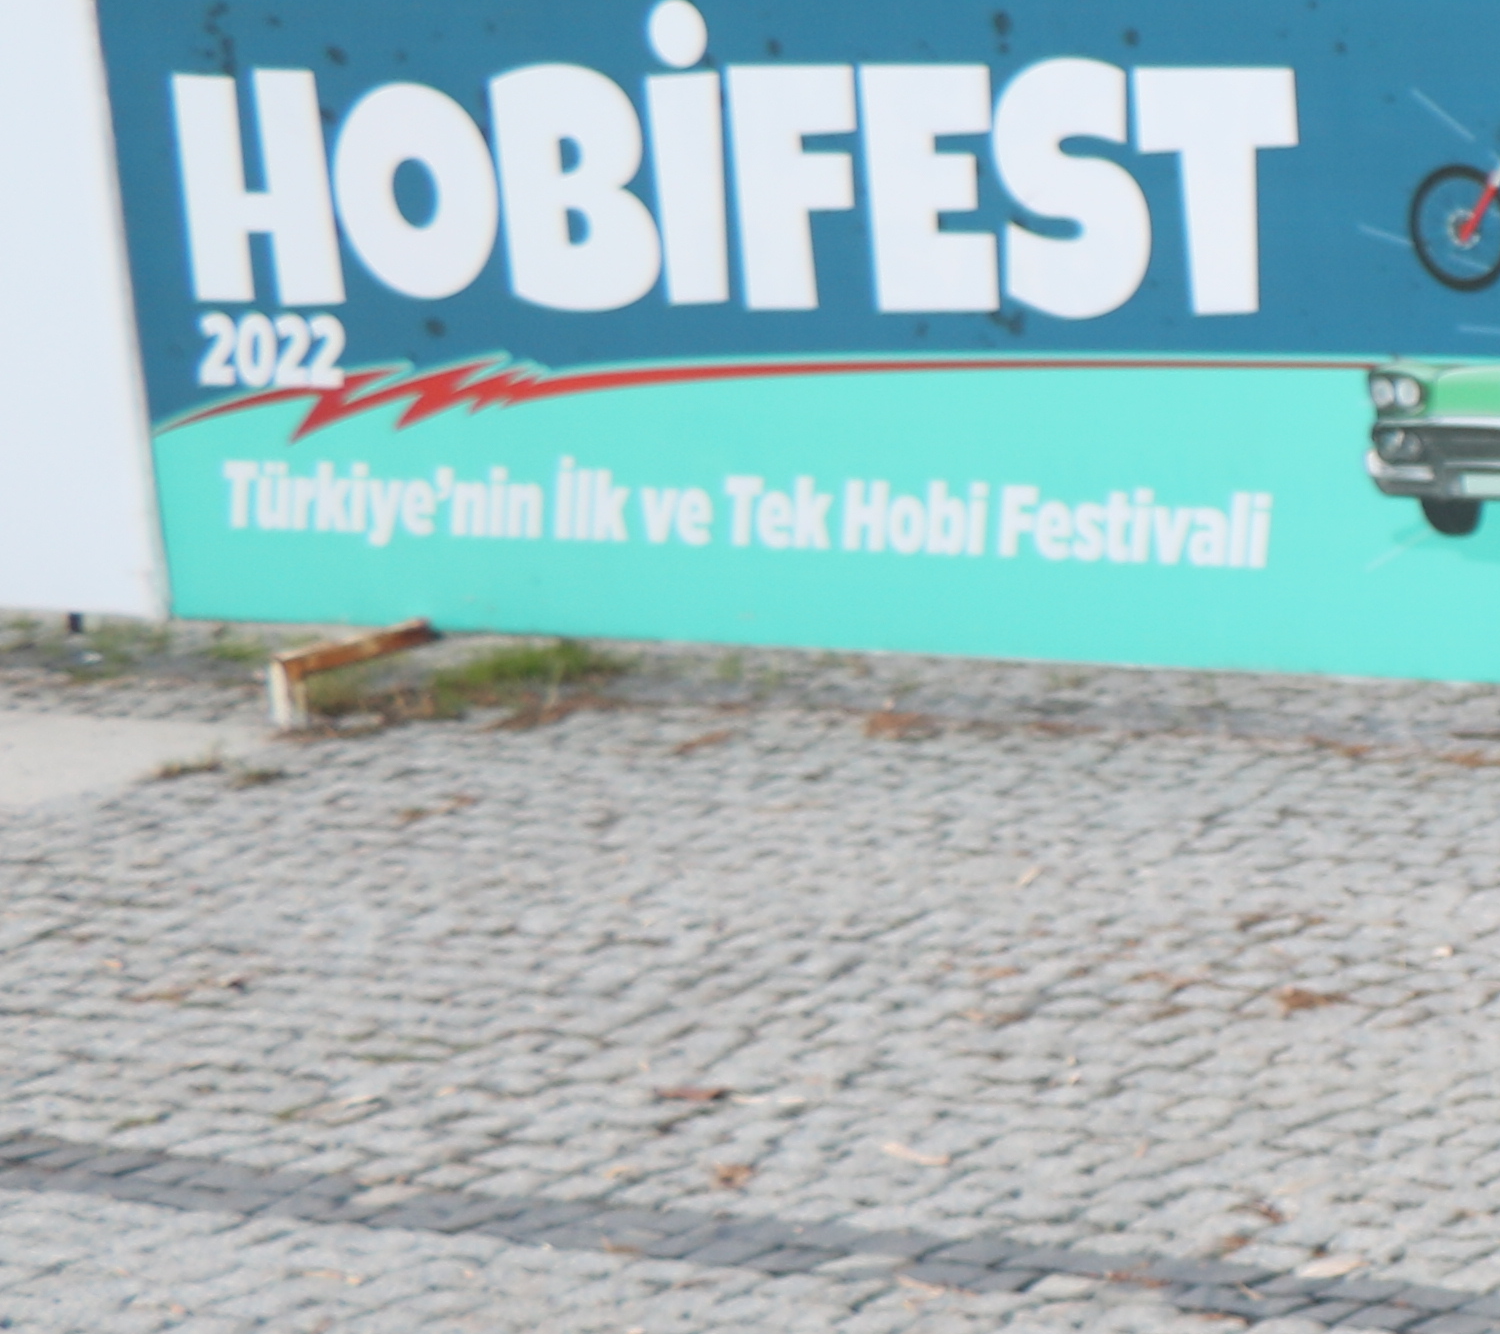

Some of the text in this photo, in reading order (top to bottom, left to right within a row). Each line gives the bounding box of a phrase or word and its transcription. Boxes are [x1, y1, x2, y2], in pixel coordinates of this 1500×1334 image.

[199, 311, 346, 391] 2022
[640, 486, 714, 546] ve
[724, 475, 832, 550] Tek
[842, 479, 989, 556] Hobi
[998, 484, 1273, 569] Festivali
